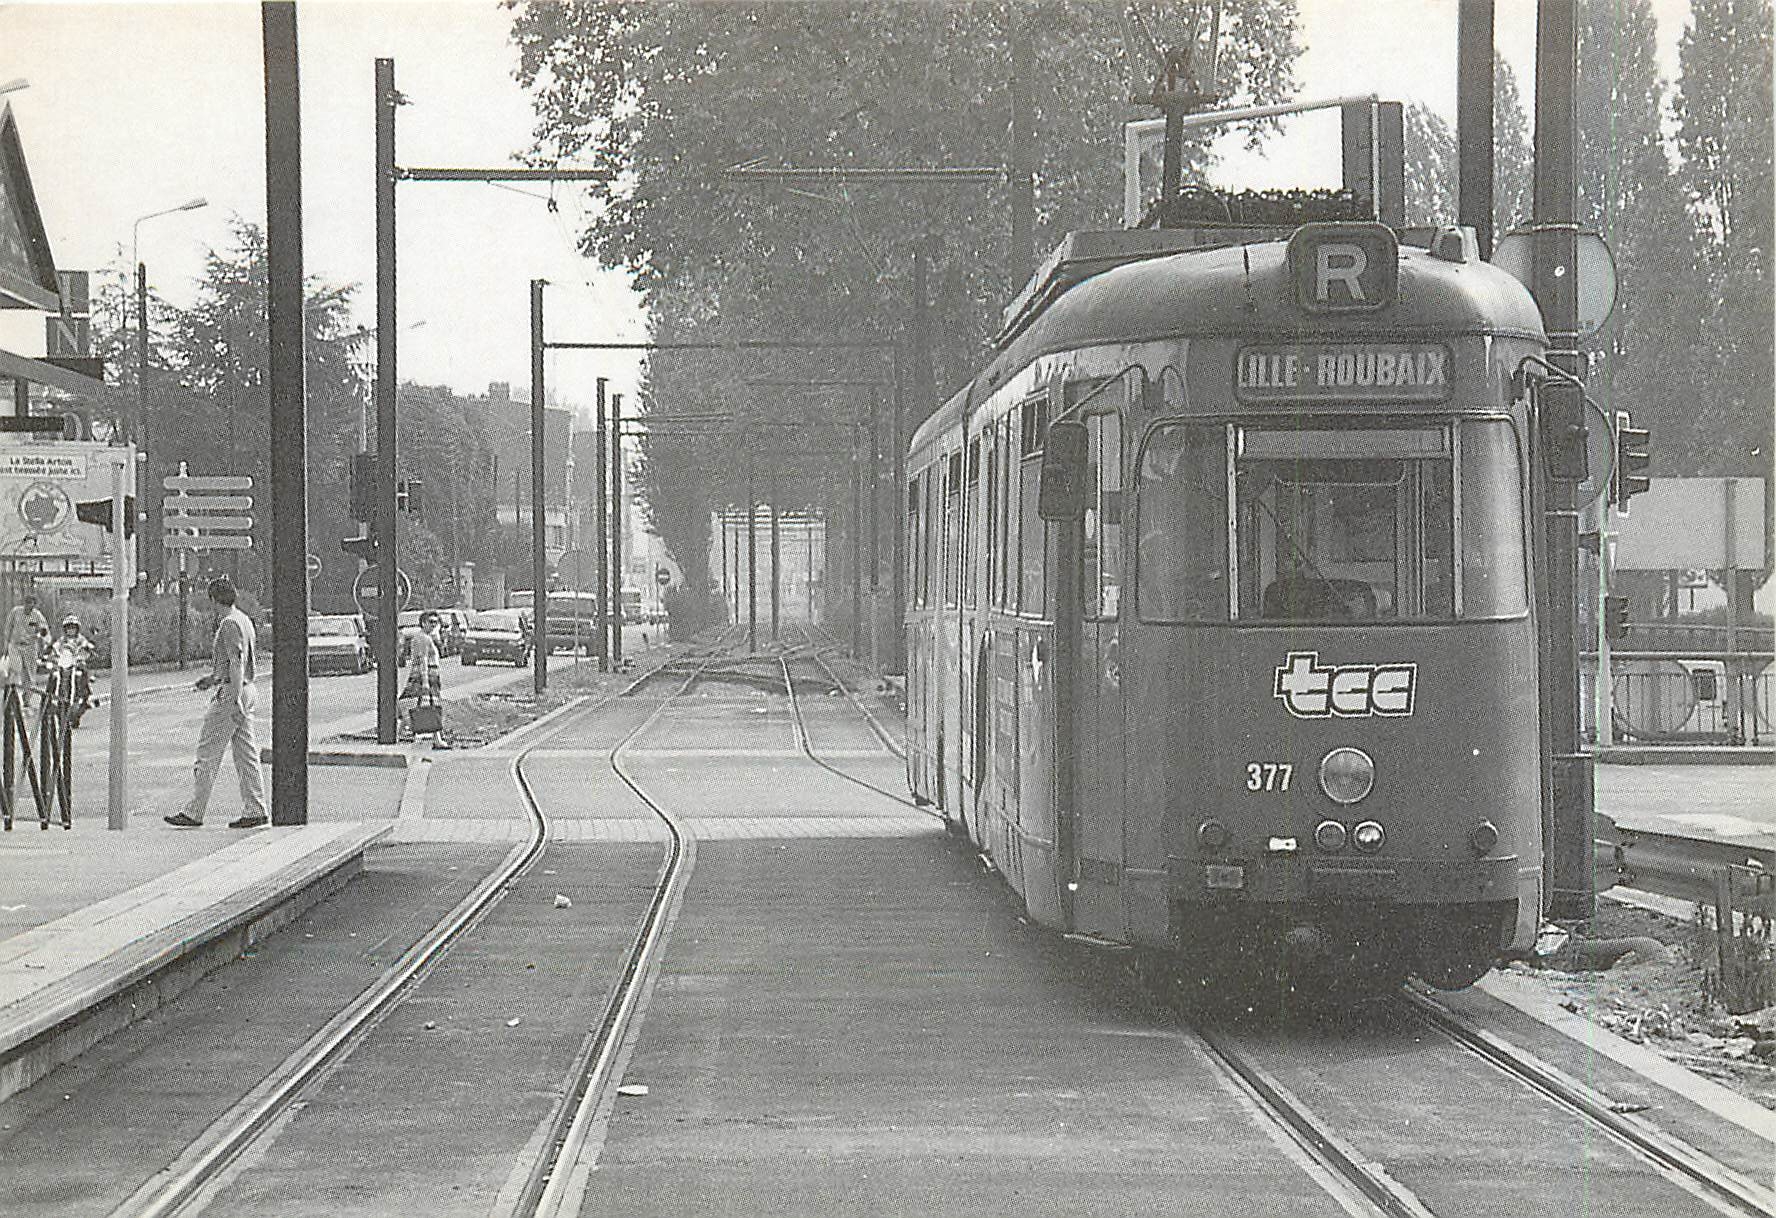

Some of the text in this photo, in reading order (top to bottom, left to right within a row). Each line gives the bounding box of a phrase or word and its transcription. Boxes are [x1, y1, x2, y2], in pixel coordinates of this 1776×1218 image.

[1317, 244, 1367, 300] R
[1237, 353, 1298, 388] LILLE
[1317, 352, 1446, 387] ROUBAIX
[1276, 653, 1415, 717] tcc
[1247, 763, 1293, 791] 377
